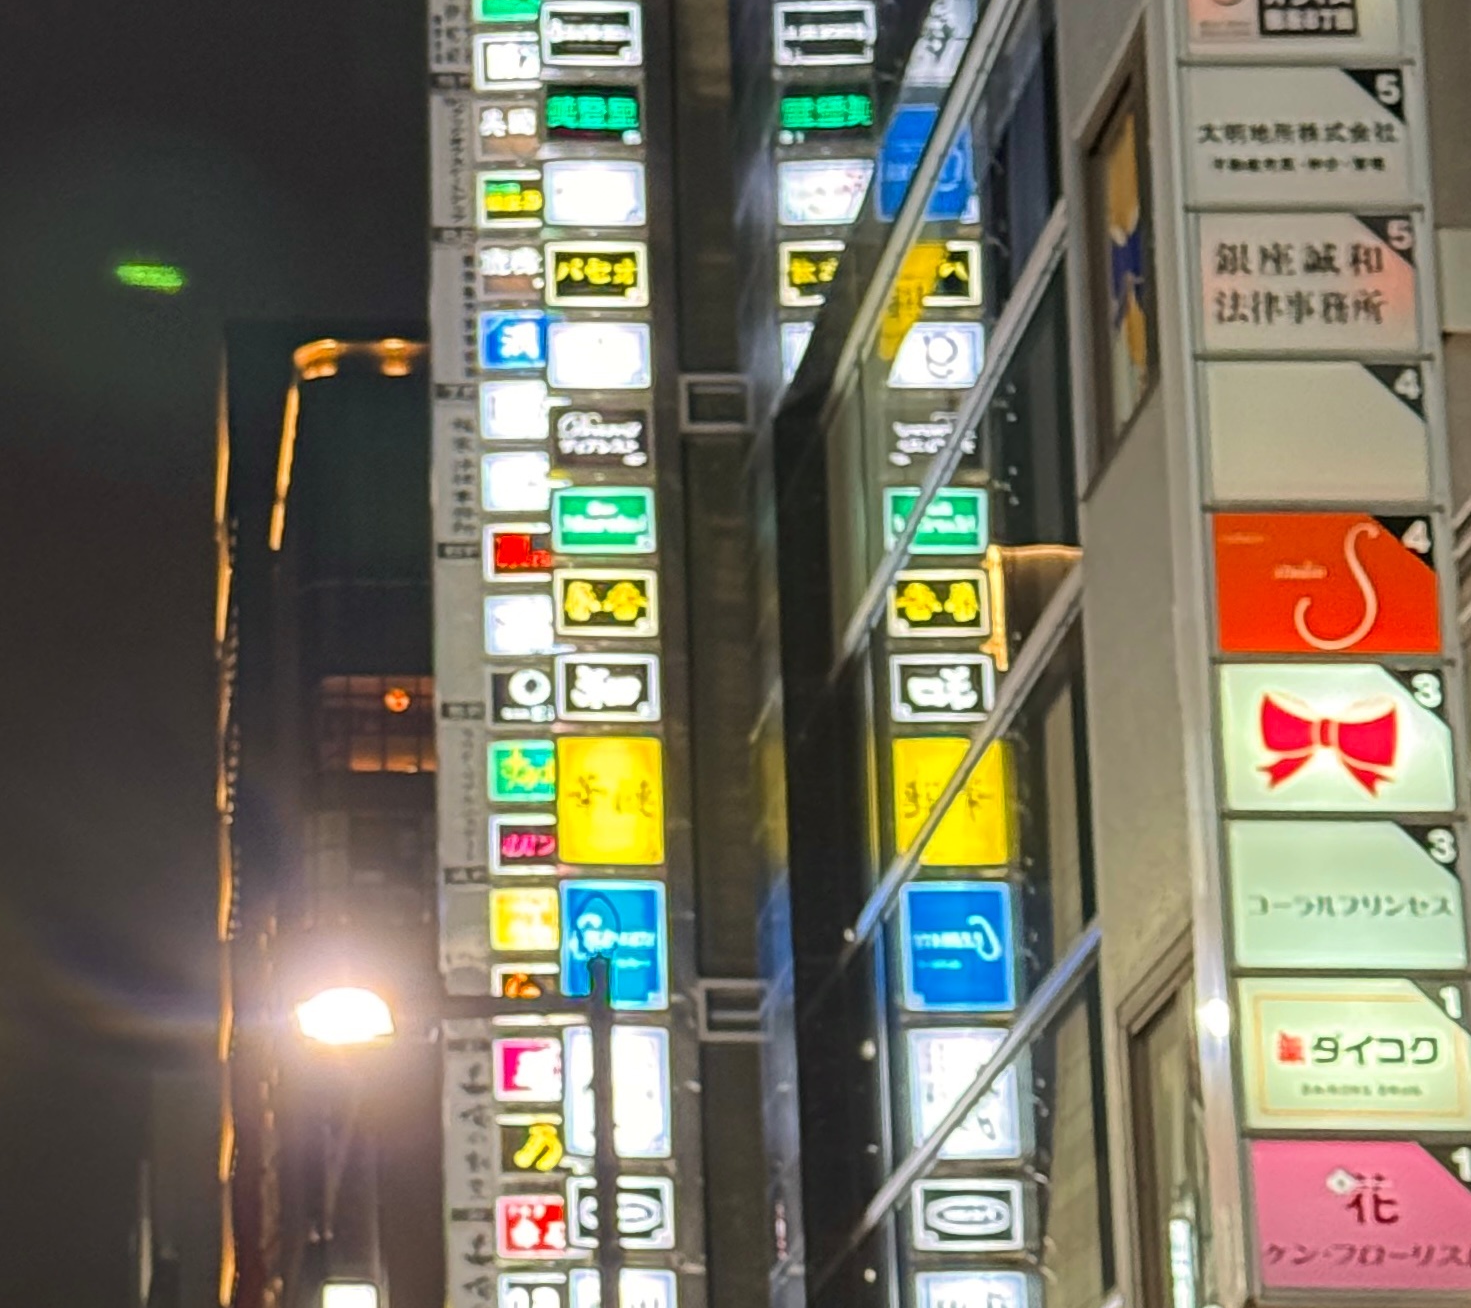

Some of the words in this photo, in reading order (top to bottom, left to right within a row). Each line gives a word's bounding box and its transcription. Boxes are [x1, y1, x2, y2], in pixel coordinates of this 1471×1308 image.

[1375, 74, 1402, 104] 5
[1387, 220, 1413, 250] 5
[1215, 290, 1389, 324] 法律事務所
[1393, 368, 1420, 400] 4
[1402, 519, 1431, 555] 4
[1428, 829, 1457, 864] 3
[1440, 986, 1461, 1019] 1
[1312, 1033, 1439, 1065] ダイコク
